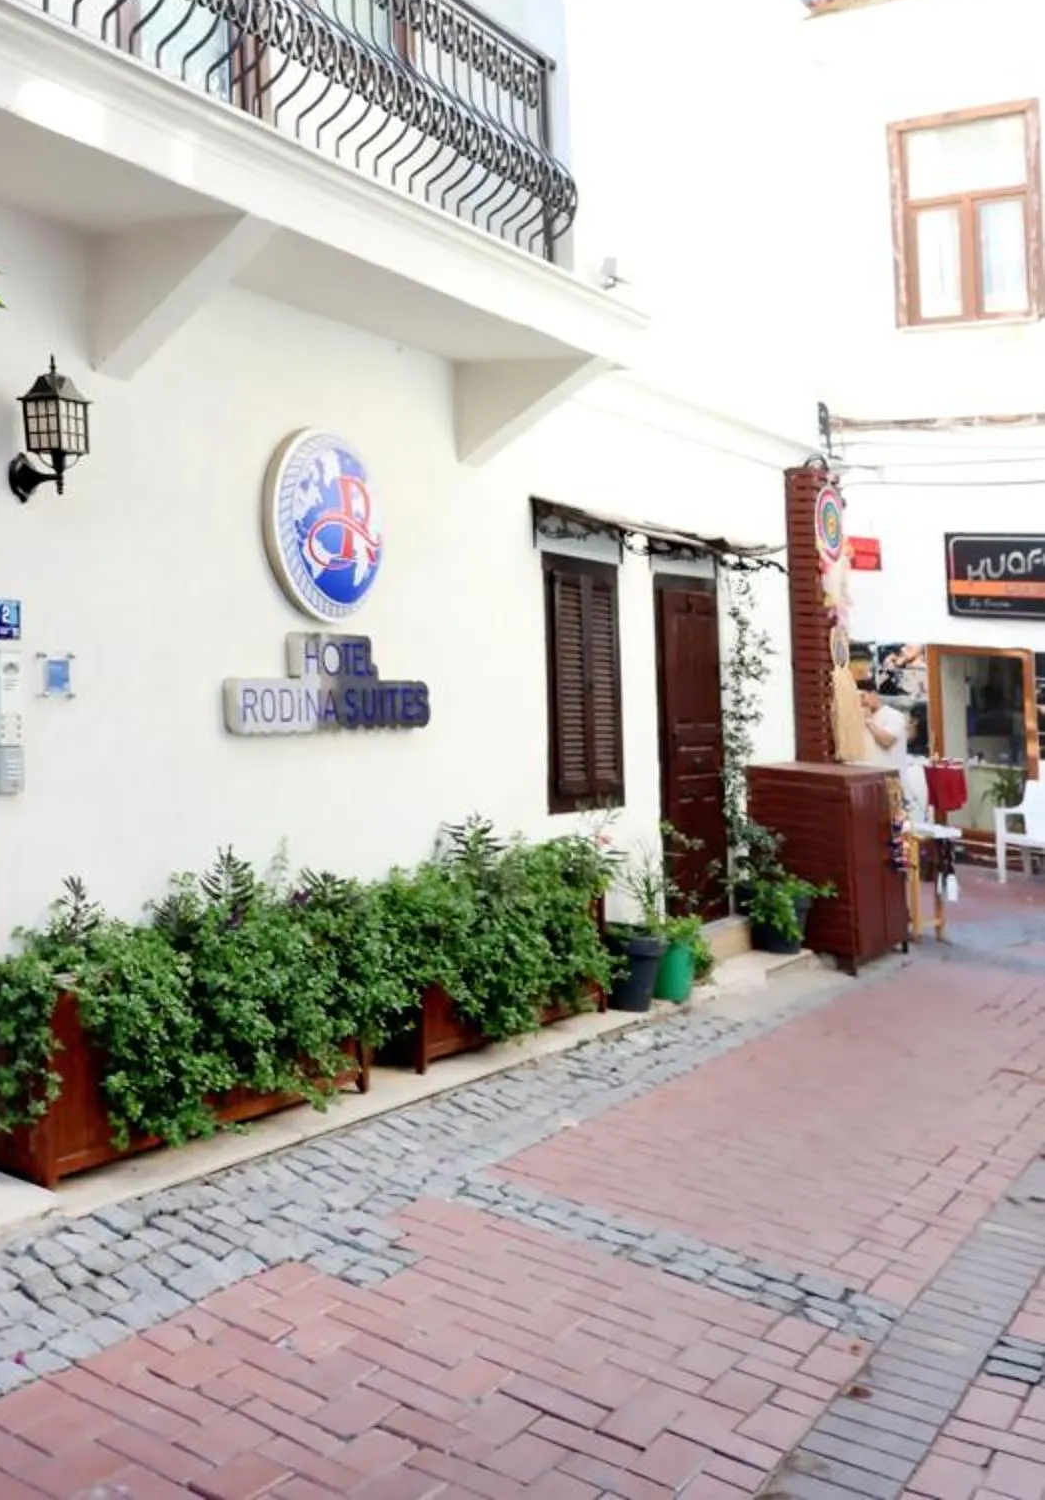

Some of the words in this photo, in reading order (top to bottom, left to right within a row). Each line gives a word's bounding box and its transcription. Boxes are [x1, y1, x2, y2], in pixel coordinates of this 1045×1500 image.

[966, 547, 1045, 583] KUAF
[304, 642, 374, 677] HOTEL
[343, 687, 429, 723] SUITES
